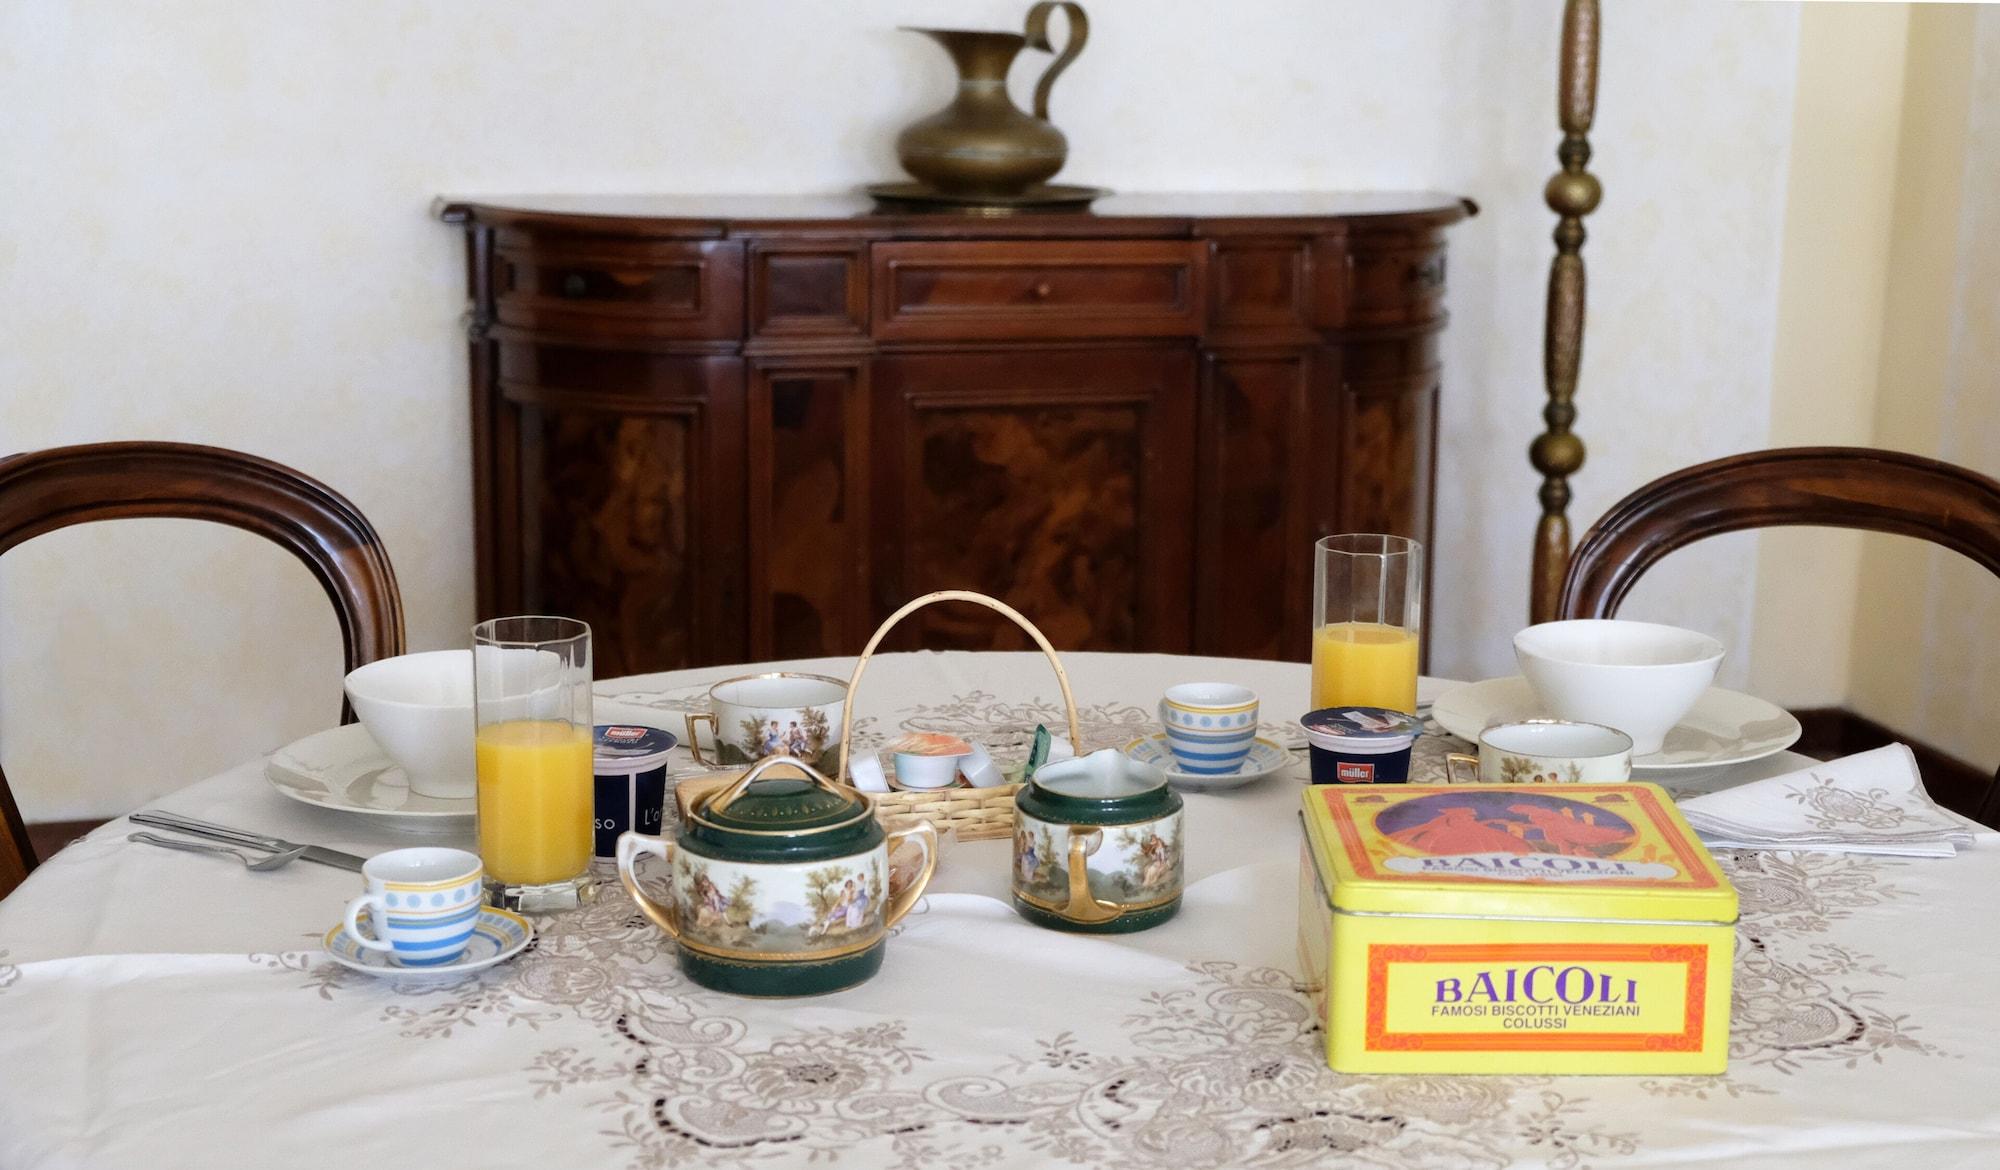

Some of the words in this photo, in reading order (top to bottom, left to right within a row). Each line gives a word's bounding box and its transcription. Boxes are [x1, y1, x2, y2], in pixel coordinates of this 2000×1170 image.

[1341, 767, 1369, 778] müller
[1422, 857, 1627, 871] BAICOLI
[1435, 966, 1638, 1005] BAICOLI
[1431, 1005, 1487, 1016] FAMOSI
[1492, 1005, 1558, 1016] BISCOTTI
[1563, 1005, 1640, 1017] VENEZIANI
[1503, 1017, 1567, 1029] COLUSSI
